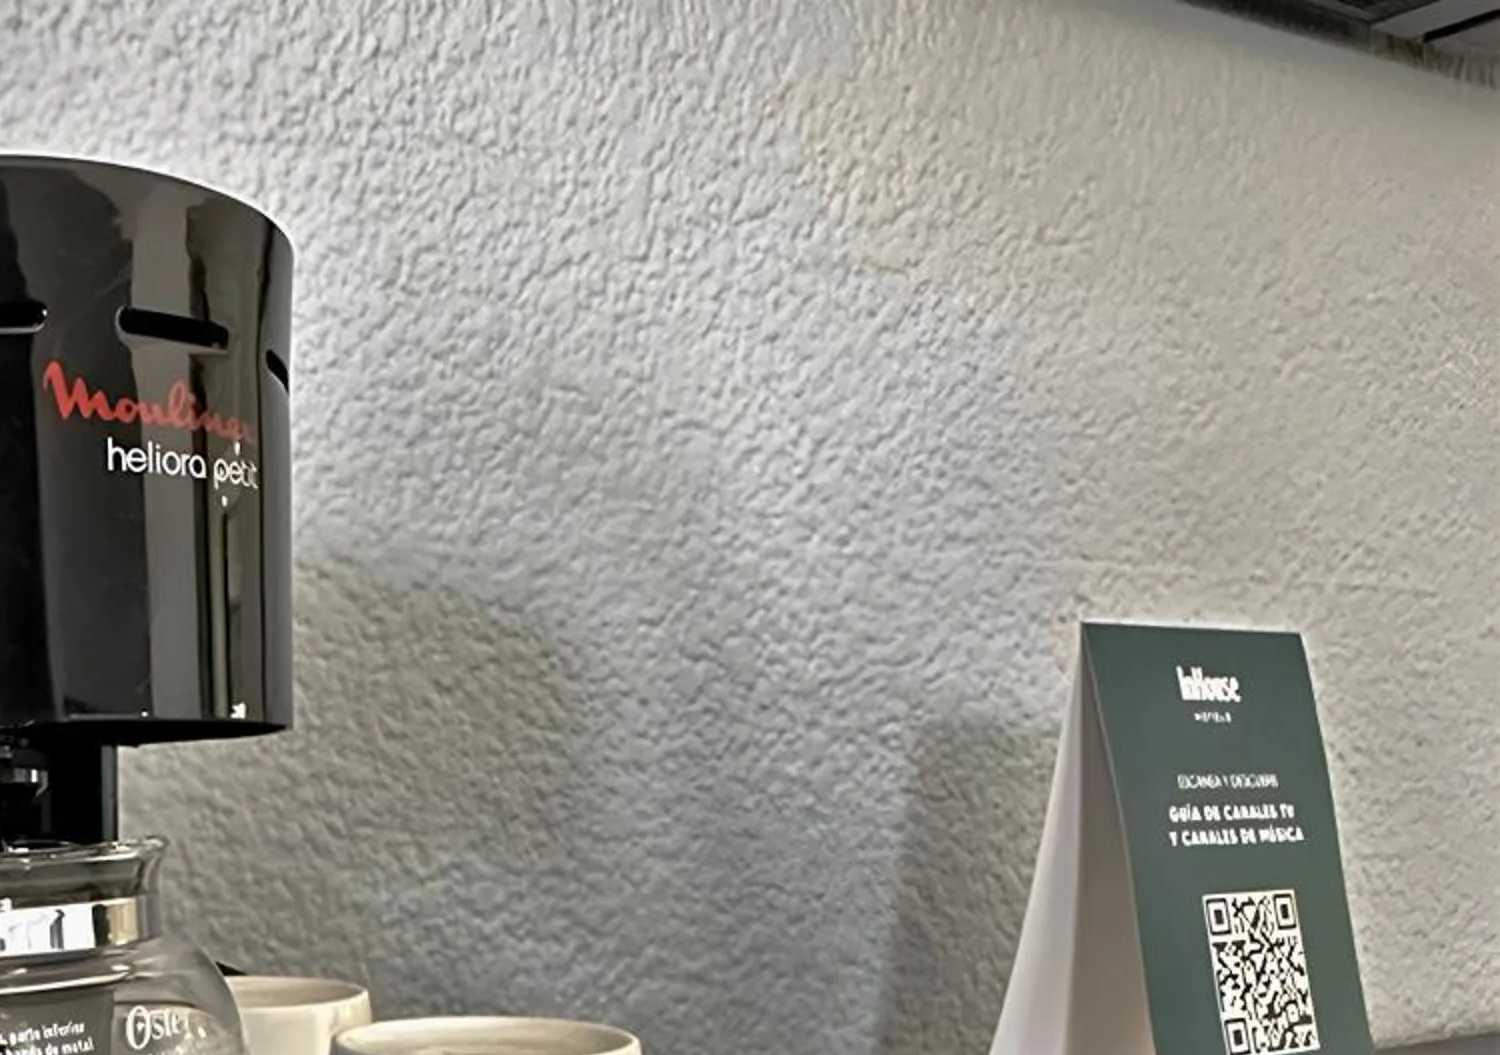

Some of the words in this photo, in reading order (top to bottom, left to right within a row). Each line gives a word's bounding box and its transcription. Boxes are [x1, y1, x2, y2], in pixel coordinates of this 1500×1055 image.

[107, 437, 206, 479] heliora
[1203, 805, 1221, 822] DE
[1223, 804, 1278, 821] CANALES
[1168, 831, 1178, 847] Y
[1181, 828, 1239, 847] CANALES
[1240, 827, 1257, 845] DE
